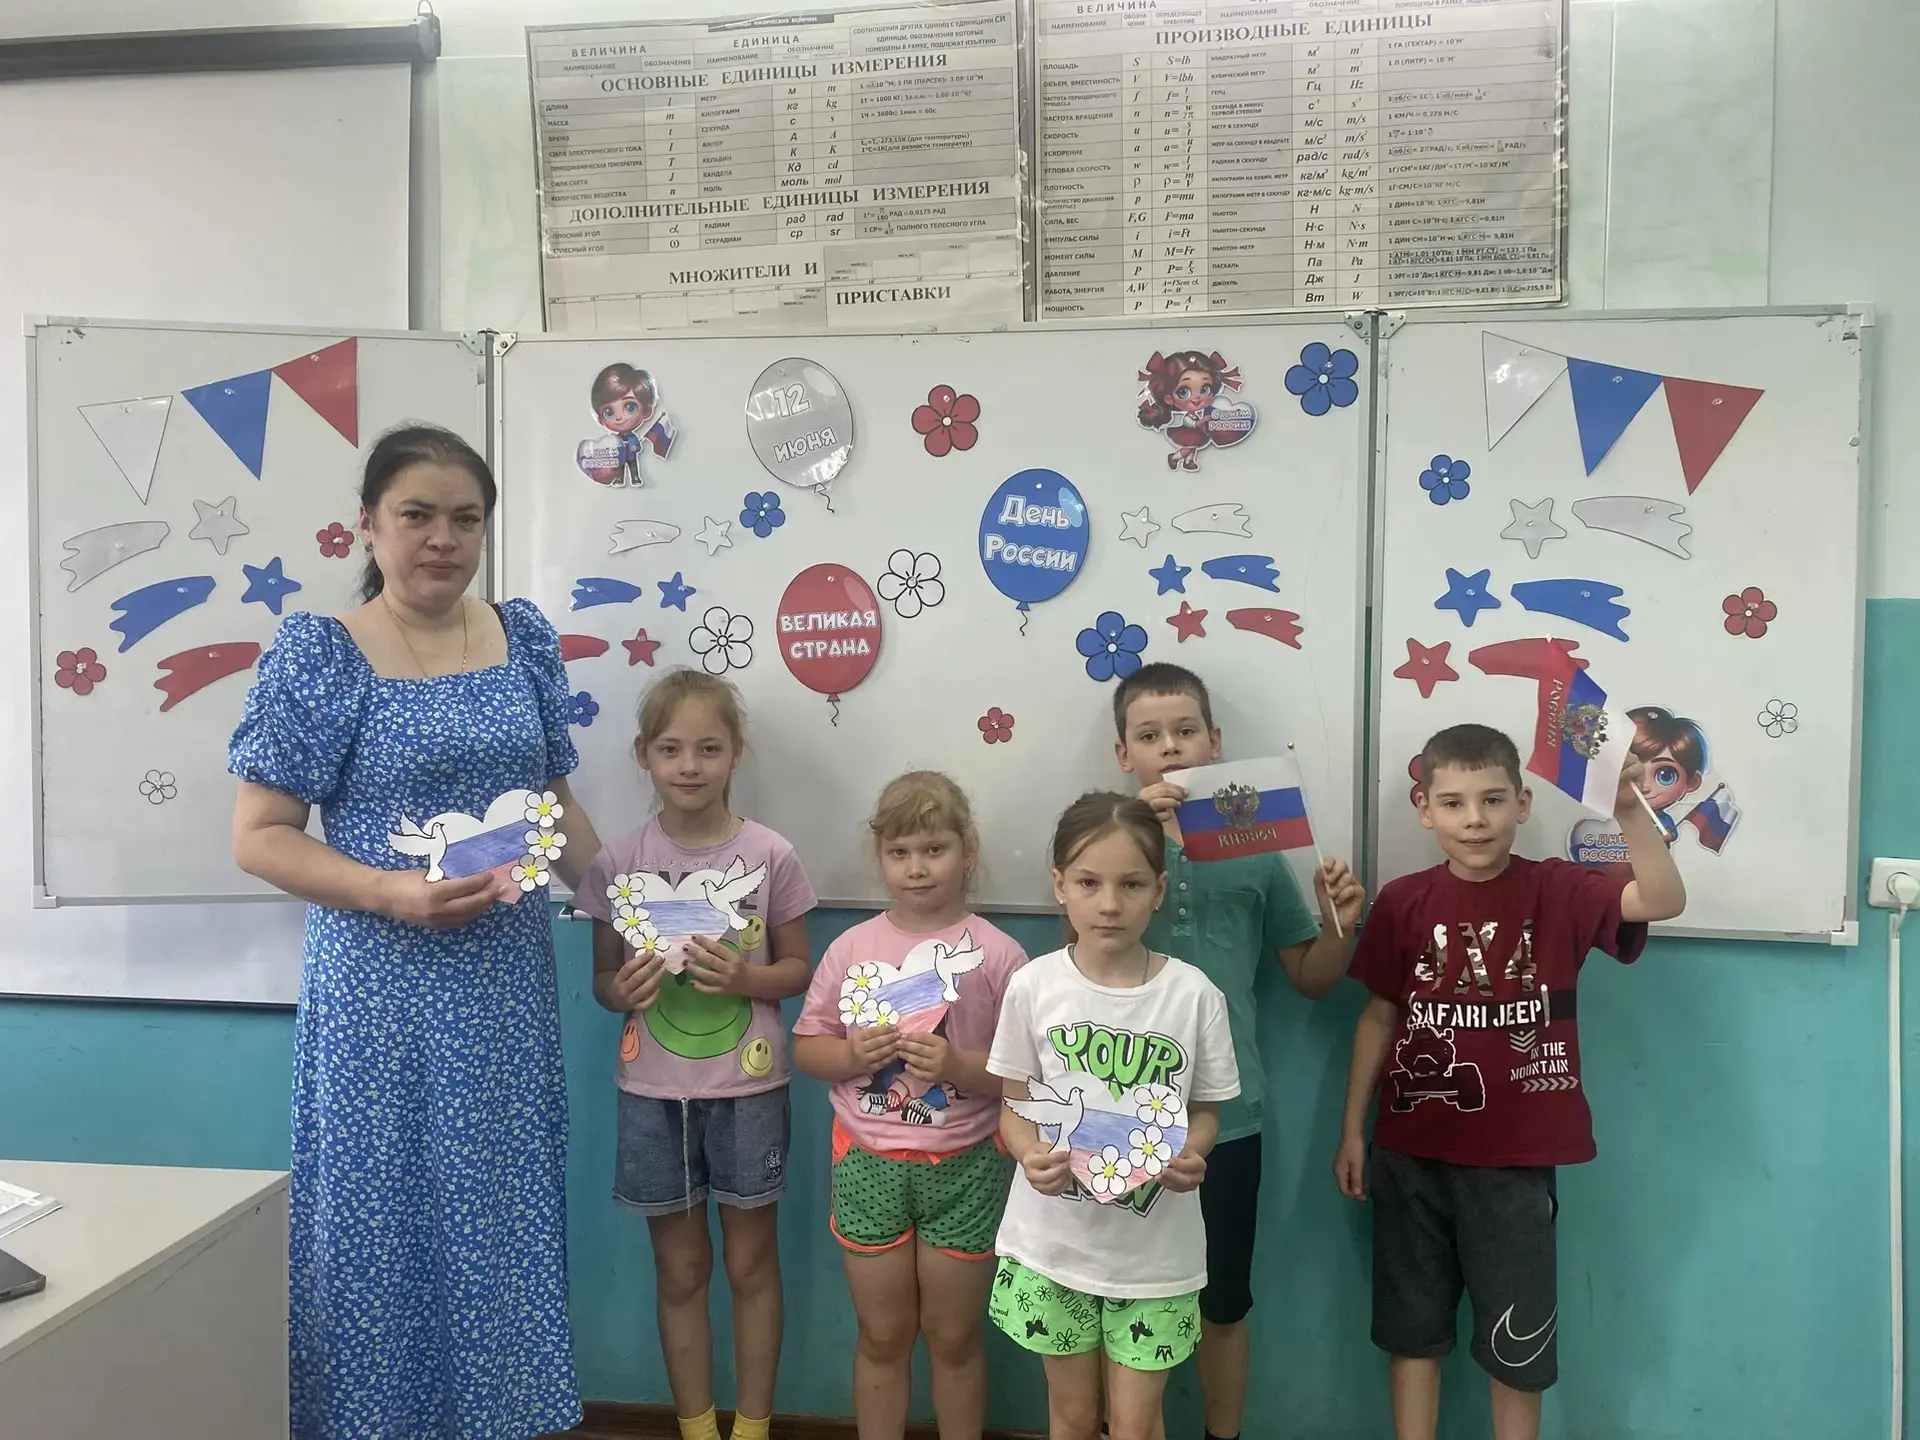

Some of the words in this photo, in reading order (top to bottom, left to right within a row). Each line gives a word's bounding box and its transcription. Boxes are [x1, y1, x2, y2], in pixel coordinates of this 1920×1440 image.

[1077, 2, 1157, 13] ВЕЛИЧИНА
[1221, 8, 1277, 18] НАИМЕНОВАНИЕ
[853, 25, 899, 34] СООТНОШЕНИЯ
[900, 22, 923, 31] ДРУГИХ
[924, 21, 949, 30] ЕДИНИЦ
[956, 18, 994, 27] ЕДИНИЦАМИ
[995, 15, 1006, 23] СИ
[1052, 21, 1106, 30] НАИМЕНОВАНИЕ
[1156, 22, 1311, 45] ПРОИЗВОДНЫЕ
[1325, 14, 1432, 36] ЕДИНИЦЫ
[910, 32, 953, 40] ОБОЗНАЧЕНИЯ
[955, 29, 984, 37] КОТОРЫХ
[733, 34, 800, 49] ЕДИНИЦА
[865, 45, 901, 53] ПОМЕЩЕНЫ
[931, 40, 964, 48] ПОДЛЕЖАТ
[1405, 39, 1436, 47] (ГЕКТАР)
[572, 45, 646, 57] ВЕЛИЧИНА
[787, 44, 834, 53] ОБОЗНАЧЕНИЕ
[707, 53, 758, 64] НАИМЕНОВАНИЕ
[1133, 57, 1140, 66] S
[1212, 53, 1251, 61] КВАДРАТНЫЙ
[563, 63, 616, 72] НАИМЕНОВАНИЕ
[644, 59, 692, 67] ОБОЗНАЧЕНИЕ
[601, 74, 709, 92] ОСНОВНЫЕ
[722, 64, 817, 85] ЕДИНИЦЫ
[832, 54, 947, 75] ИЗМЕРЕНИЯ
[1071, 77, 1120, 86] ВМЕСТИМОСТЬ
[1307, 81, 1321, 92] Гц
[1350, 79, 1364, 89] Hz
[666, 112, 674, 120] m
[701, 108, 740, 117] КИЛОГРАММ
[1076, 112, 1113, 120] ВРАЩЕНИЯ
[1305, 118, 1323, 127] м/с
[1347, 115, 1366, 125] m/s
[701, 124, 730, 132] СЕКУНДА
[548, 135, 570, 143] ВРЕМЯ
[702, 140, 723, 148] АМПЕР
[702, 155, 732, 163] КЕЛЬВИН
[1296, 151, 1328, 163] рад/с
[1343, 149, 1369, 160] rad/s
[787, 162, 802, 172] Кд
[827, 160, 839, 169] cd
[703, 170, 732, 178] КАНДЕЛА
[781, 177, 809, 186] моль
[824, 175, 842, 185] mol
[593, 191, 626, 199] ВЕЩЕСТВА
[570, 199, 750, 223] ДОПОЛНИТЕЛЬНЫЕ
[763, 189, 858, 210] ЕДИНИЦЫ
[873, 181, 990, 201] ИЗМЕРЕНИЯ
[786, 212, 805, 225] рад
[826, 212, 844, 222] rad
[1128, 212, 1147, 223] F,G
[1165, 212, 1194, 221] F=ma
[704, 221, 730, 229] РАДИАН
[897, 223, 928, 231] ПОЛНОГО
[930, 221, 966, 229] ТЕЛЕСНОГО
[790, 228, 803, 238] ср
[830, 227, 840, 236] sr
[1169, 229, 1191, 238] i=Ft
[705, 235, 742, 245] СТЕРАДИАН
[1165, 246, 1195, 256] M=Fr
[1308, 258, 1322, 267] Па
[1351, 256, 1363, 266] Pa
[669, 263, 790, 285] МНОЖИТЕЛИ
[805, 262, 817, 275] И
[1305, 274, 1324, 285] Дж
[836, 286, 951, 305] ПРИСТАВКИ
[1352, 291, 1363, 300] W
[773, 383, 811, 417] 12
[773, 426, 837, 463] ИЮНЯ
[998, 495, 1071, 529] День
[984, 534, 1078, 571] России
[781, 610, 877, 632] ВЕЛИКАЯ
[790, 638, 870, 658] СТРАНА
[1547, 678, 1563, 748] РОССИЯ
[1584, 833, 1594, 845] С
[1597, 833, 1628, 846] ДНЁ
[1414, 918, 1537, 997] 4X4
[1411, 1002, 1487, 1028] SAFARI
[1493, 999, 1542, 1028] JEEP
[1050, 1024, 1184, 1087] YOUR
[1531, 1046, 1540, 1060] IN
[1542, 1042, 1566, 1057] THE
[1510, 1059, 1569, 1081] MOUNTAIN
